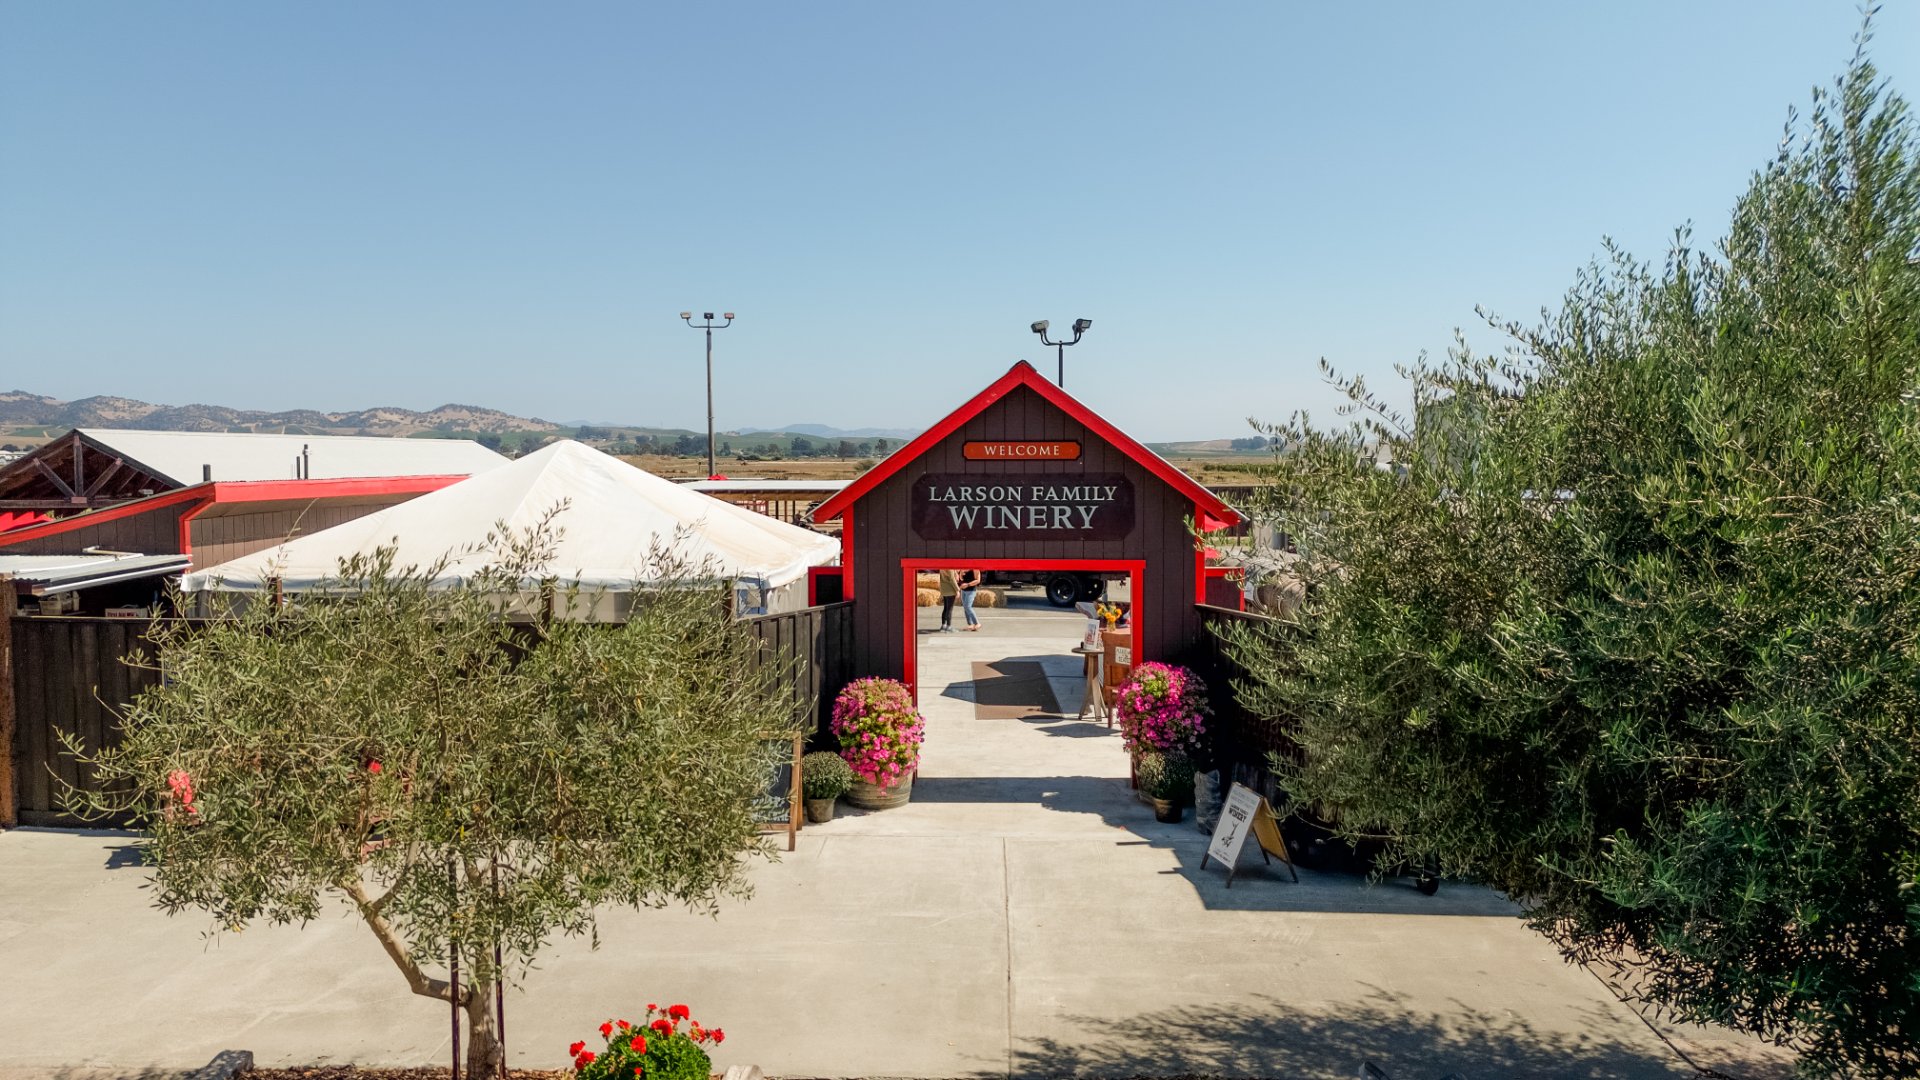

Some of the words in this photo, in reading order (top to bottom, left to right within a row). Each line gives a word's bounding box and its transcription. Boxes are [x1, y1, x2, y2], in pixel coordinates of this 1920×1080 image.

[984, 445, 1060, 456] WELCOME
[928, 486, 1023, 501] LARSON
[1031, 486, 1117, 501] FAMILY
[947, 505, 1099, 529] WINERY
